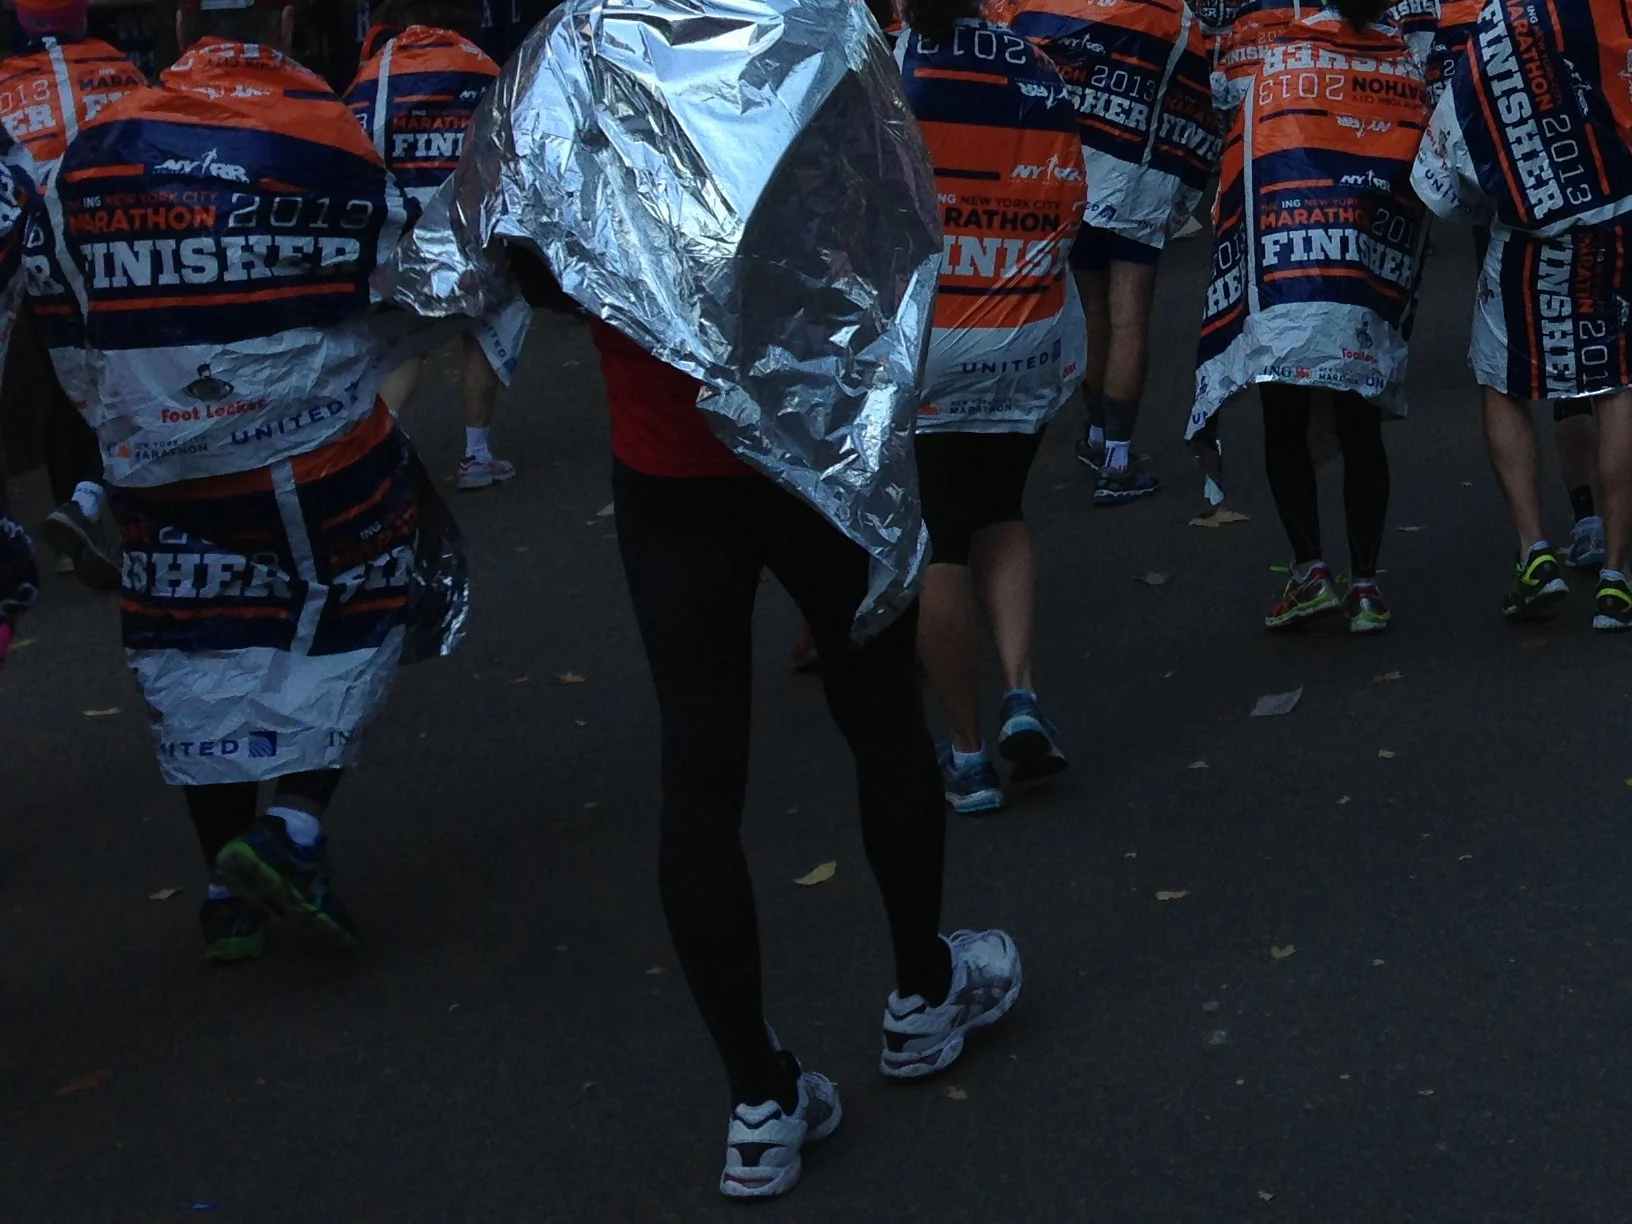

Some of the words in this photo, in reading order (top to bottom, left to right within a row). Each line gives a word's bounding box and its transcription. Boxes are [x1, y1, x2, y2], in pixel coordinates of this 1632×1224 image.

[1527, 5, 1539, 24] ING
[1091, 64, 1157, 102] 2013
[1259, 73, 1345, 105] 2013
[1542, 114, 1592, 206] 2013
[140, 192, 178, 204] YORK
[182, 190, 218, 203] CITY
[961, 195, 989, 206] NEW
[995, 197, 1029, 209] YORK
[1033, 200, 1061, 210] CITY
[1281, 199, 1301, 209] ING
[228, 192, 373, 229] 2013
[962, 352, 1048, 373] UNITED
[162, 407, 199, 423] Foot
[232, 399, 343, 445] UNITED
